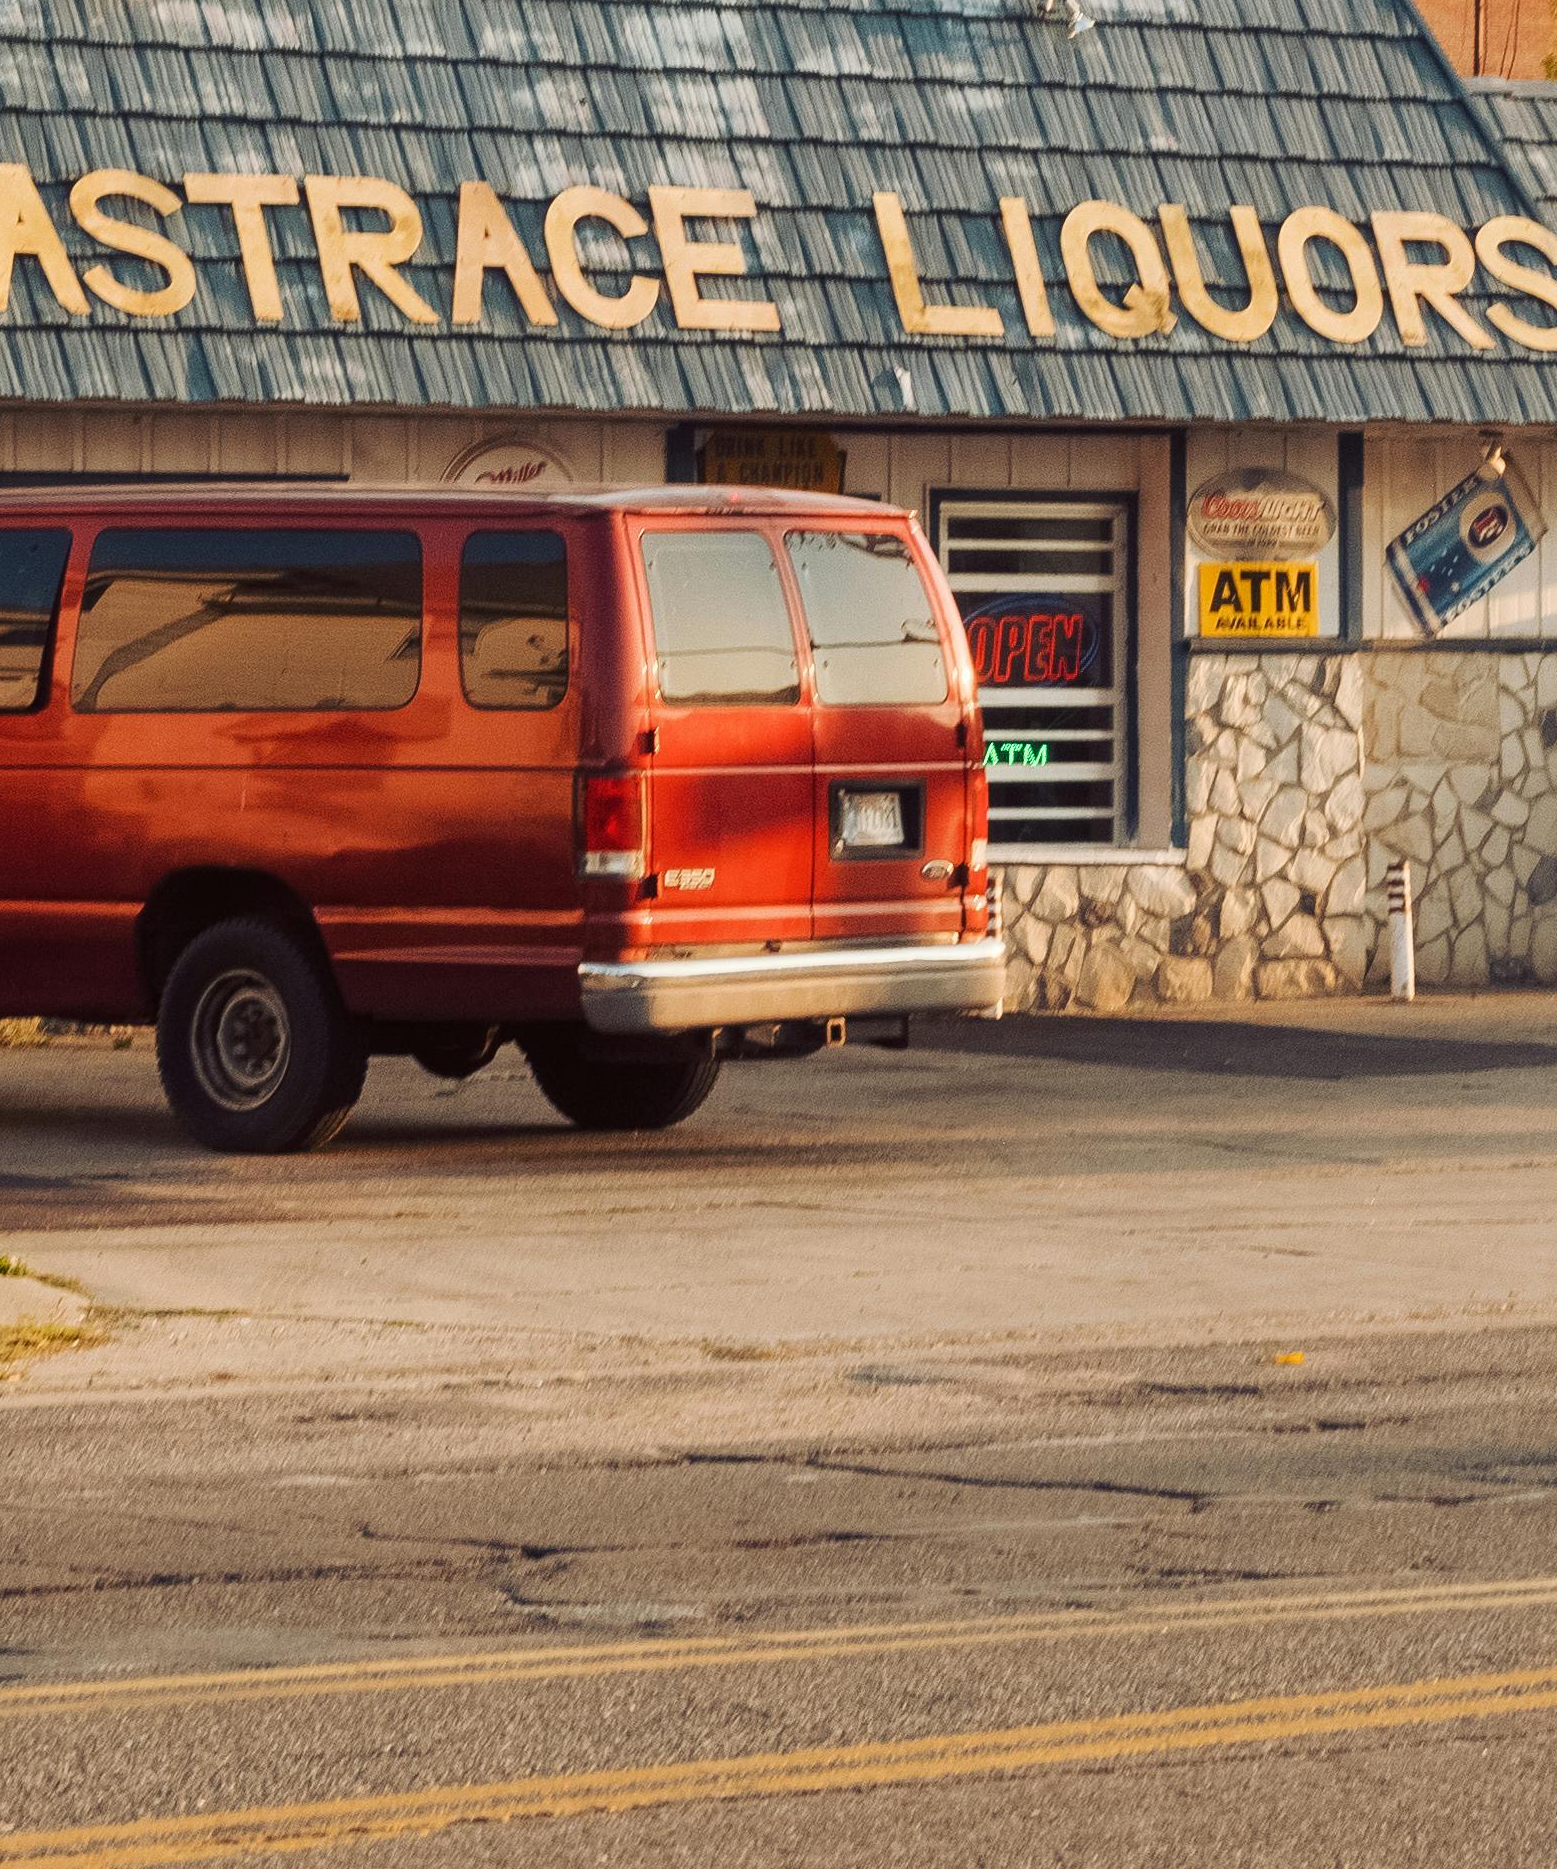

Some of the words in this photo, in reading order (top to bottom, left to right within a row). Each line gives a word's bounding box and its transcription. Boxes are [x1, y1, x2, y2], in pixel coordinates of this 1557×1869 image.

[1209, 570, 1311, 613] ATM
[1215, 616, 1307, 631] AVAILABLE
[967, 613, 1084, 683] OPEN
[983, 741, 1048, 767] ATM
